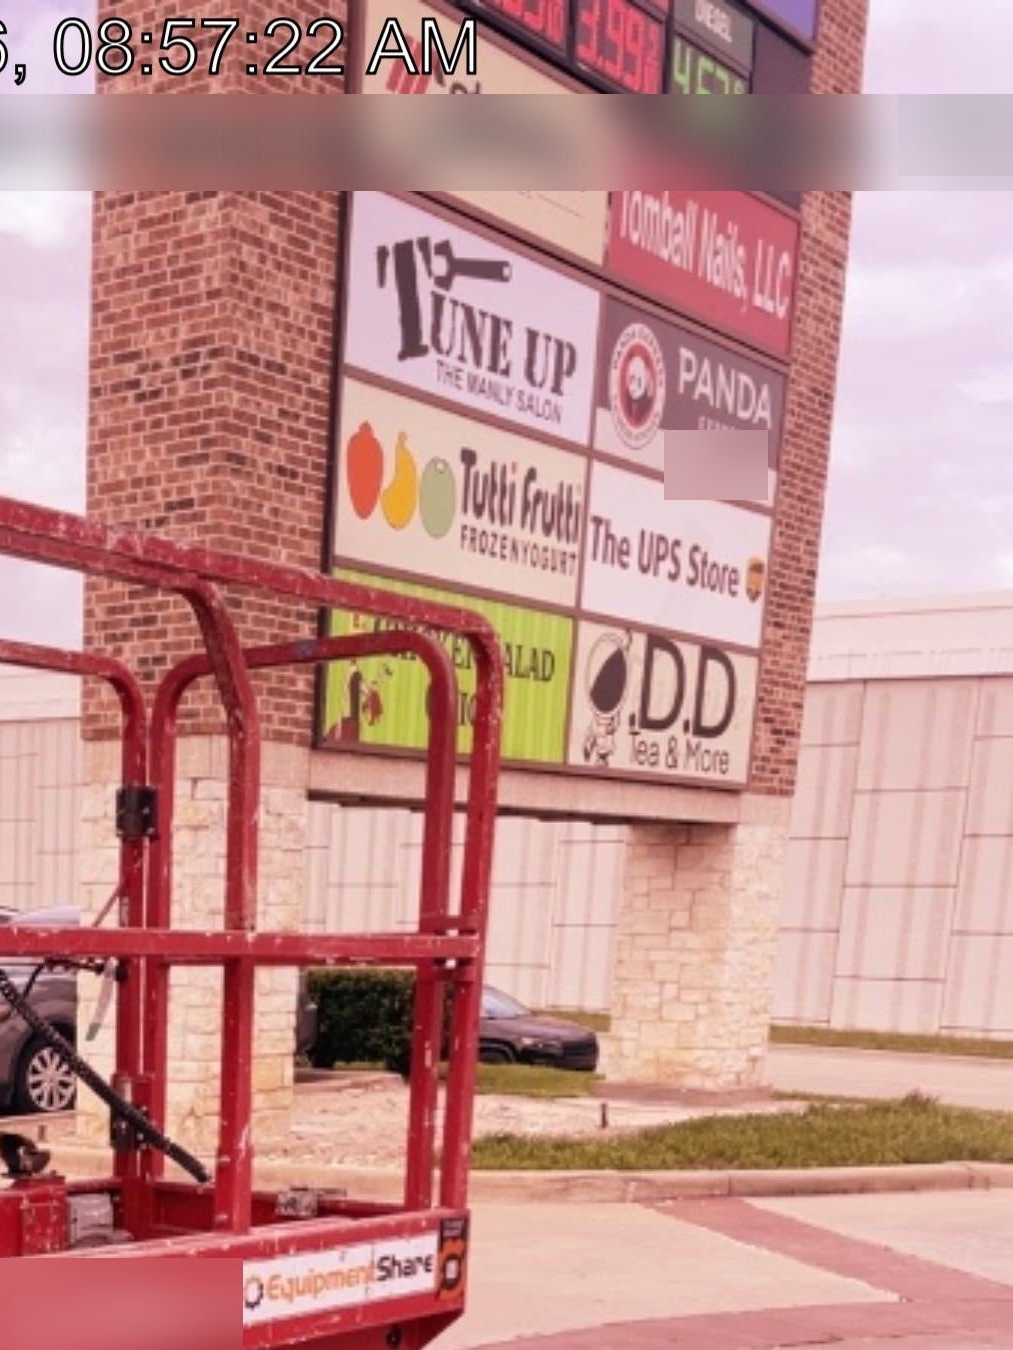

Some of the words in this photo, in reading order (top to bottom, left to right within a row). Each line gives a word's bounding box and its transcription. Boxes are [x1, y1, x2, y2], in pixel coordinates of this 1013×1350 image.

[377, 236, 513, 378] TUNE
[524, 326, 577, 397] UP
[752, 239, 791, 319] LLC
[436, 359, 463, 391] THE
[466, 370, 514, 407] MANLY
[515, 389, 562, 424] SALON
[678, 346, 772, 430] PANDA
[460, 446, 518, 526] Tutti
[520, 466, 582, 545] Frutti
[590, 515, 630, 570] The
[638, 528, 681, 583] UPS
[686, 543, 740, 598] Store
[501, 641, 555, 682] ALAD
[629, 730, 660, 767] Tea
[665, 735, 678, 769] &
